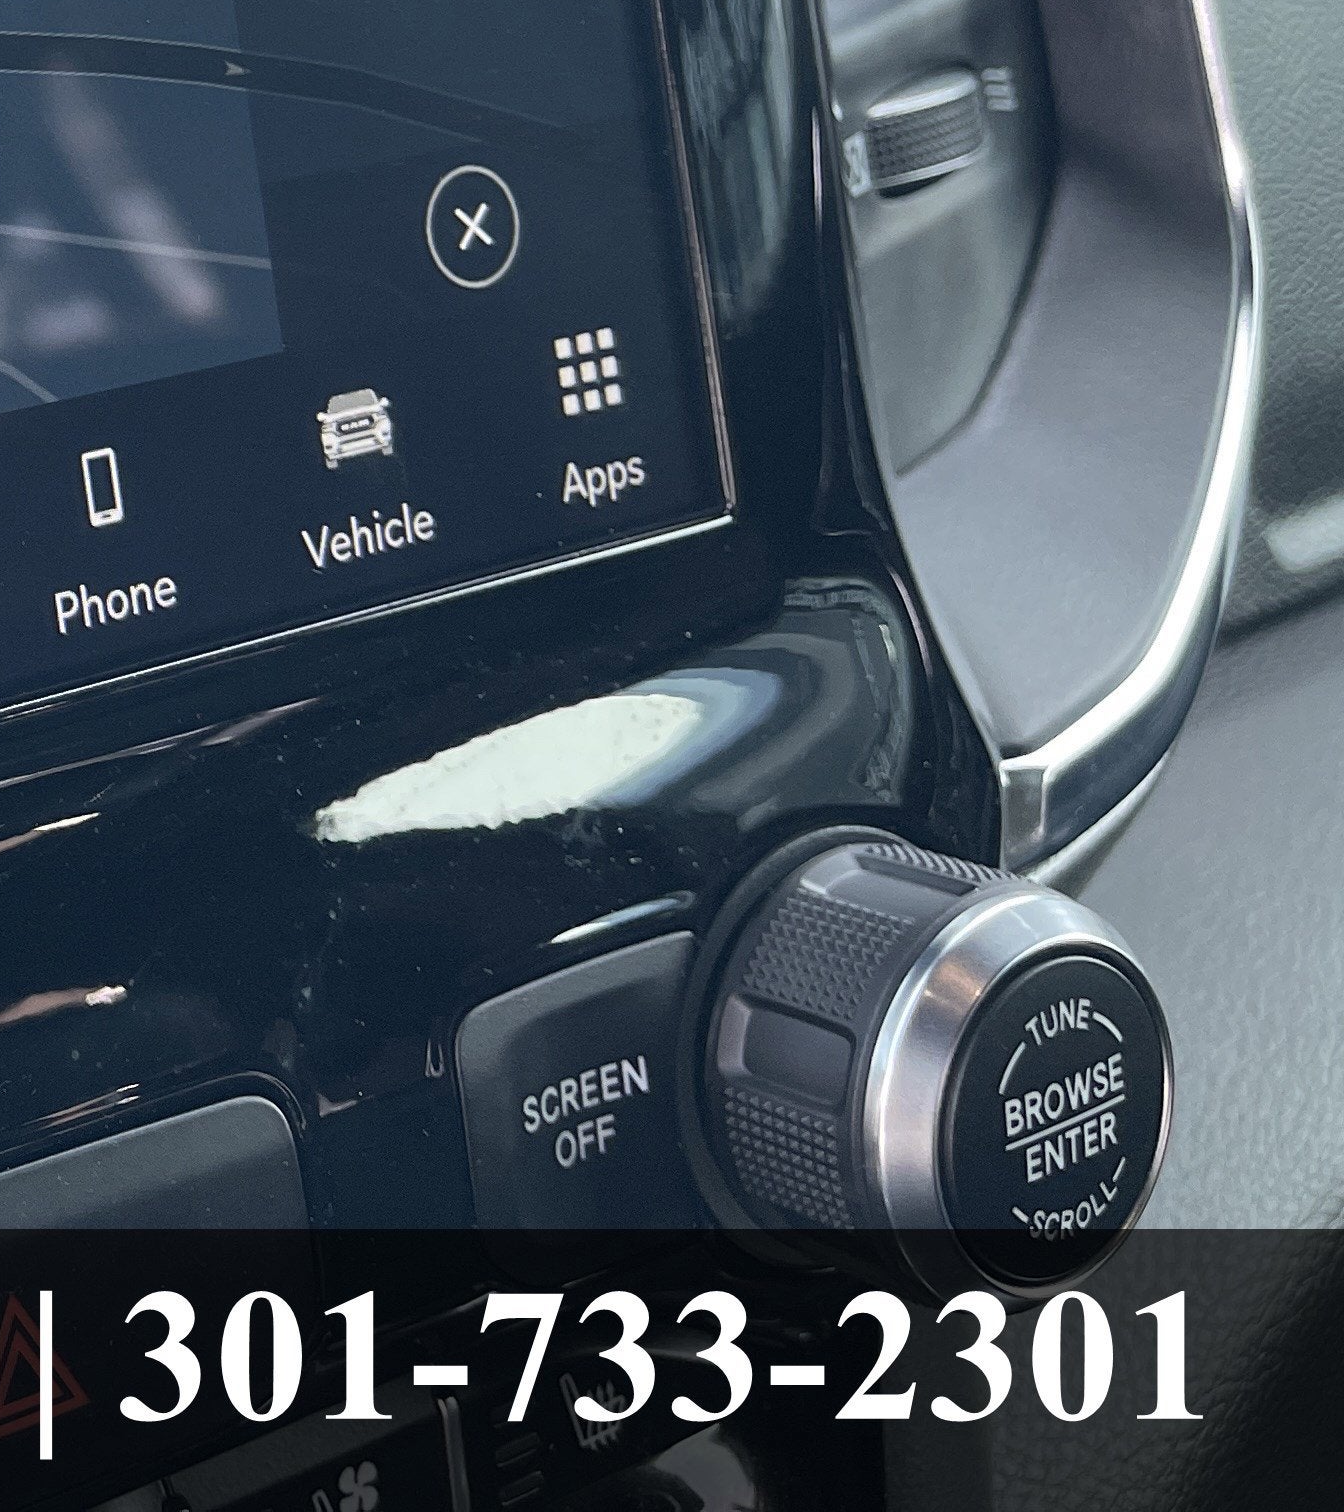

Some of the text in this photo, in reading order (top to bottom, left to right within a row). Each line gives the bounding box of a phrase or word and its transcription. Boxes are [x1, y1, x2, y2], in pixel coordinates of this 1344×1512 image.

[562, 453, 647, 506] Apps
[301, 503, 437, 569] Vehicle
[54, 576, 178, 635] Phone
[1024, 997, 1092, 1045] TUNE
[522, 1055, 651, 1135] SCREEN
[1004, 1053, 1126, 1138] BROWSE
[554, 1114, 617, 1169] OFF
[1025, 1113, 1120, 1185] ENTER
[1027, 1182, 1120, 1242] SCROLL
